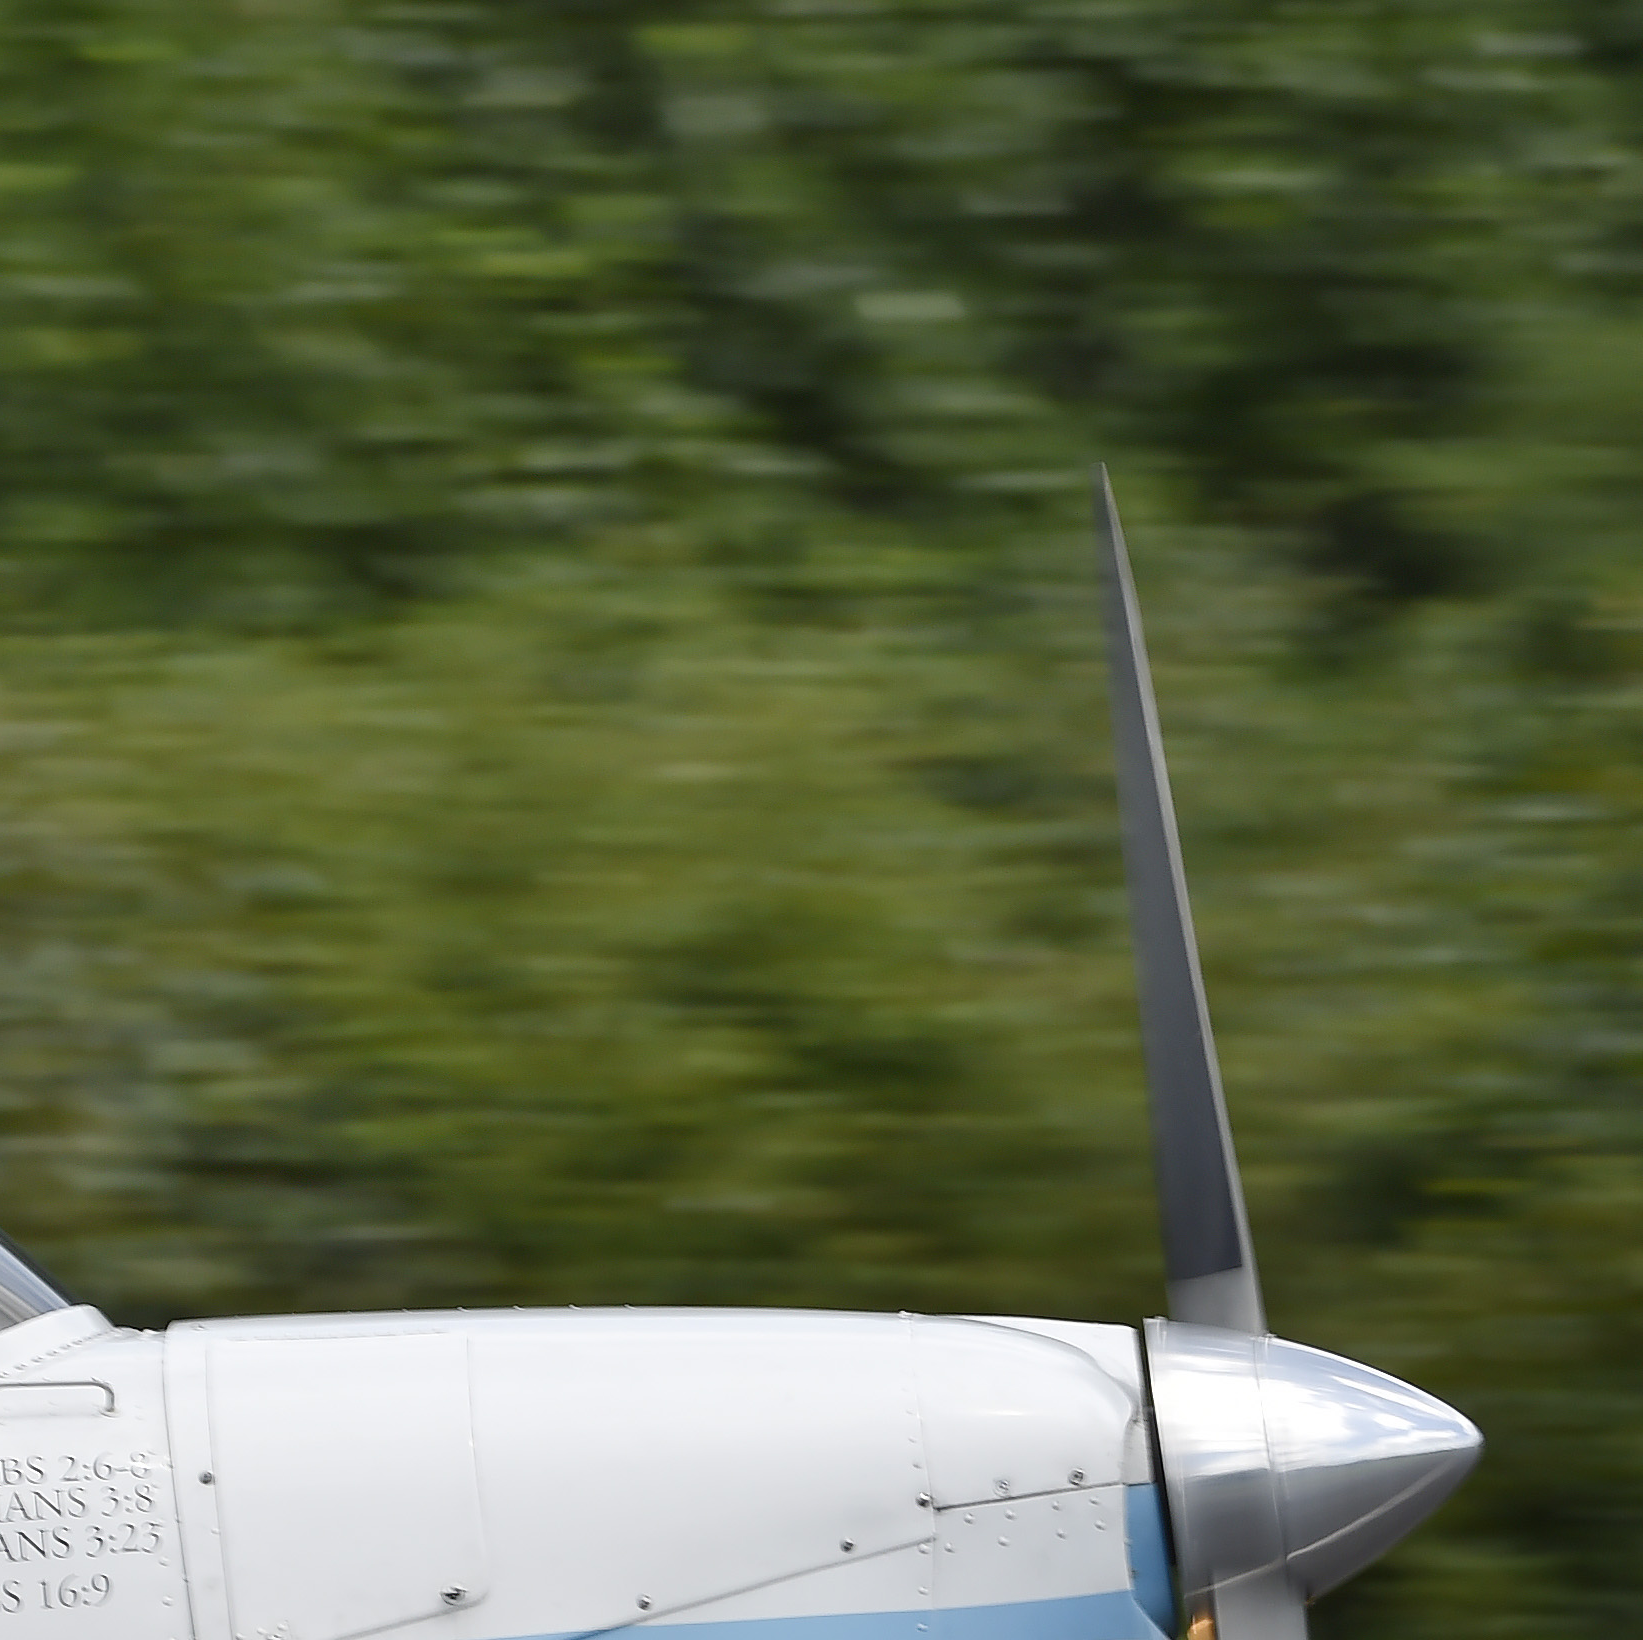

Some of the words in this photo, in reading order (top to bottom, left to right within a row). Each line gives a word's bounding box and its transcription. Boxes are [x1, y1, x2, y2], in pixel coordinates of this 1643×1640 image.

[100, 1484, 154, 1517] 3:8
[84, 1521, 163, 1558] 3:23
[39, 1573, 112, 1609] 16:9
